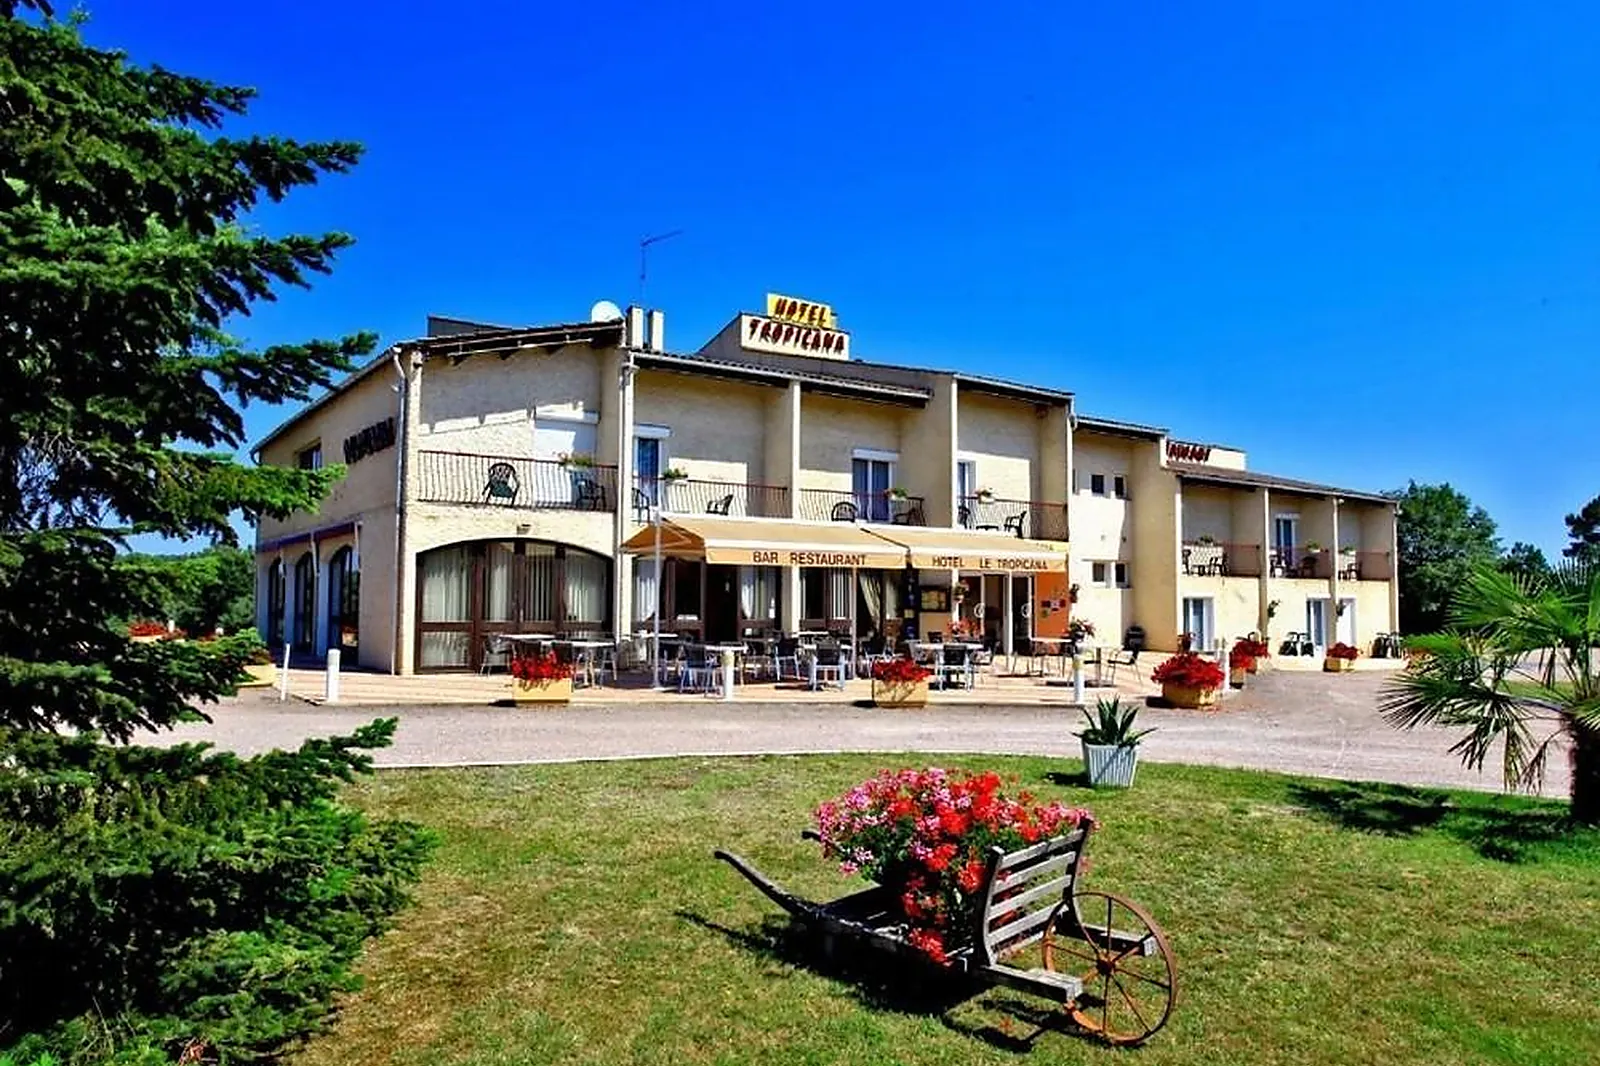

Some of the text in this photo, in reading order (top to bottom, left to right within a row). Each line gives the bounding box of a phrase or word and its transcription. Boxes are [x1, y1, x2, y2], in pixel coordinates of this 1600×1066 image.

[774, 297, 827, 323] HOTEL
[749, 319, 844, 354] TROPICANA
[753, 551, 866, 566] BAR RESTAURANT
[932, 556, 1048, 570] HOTEL LE TROPICANA
